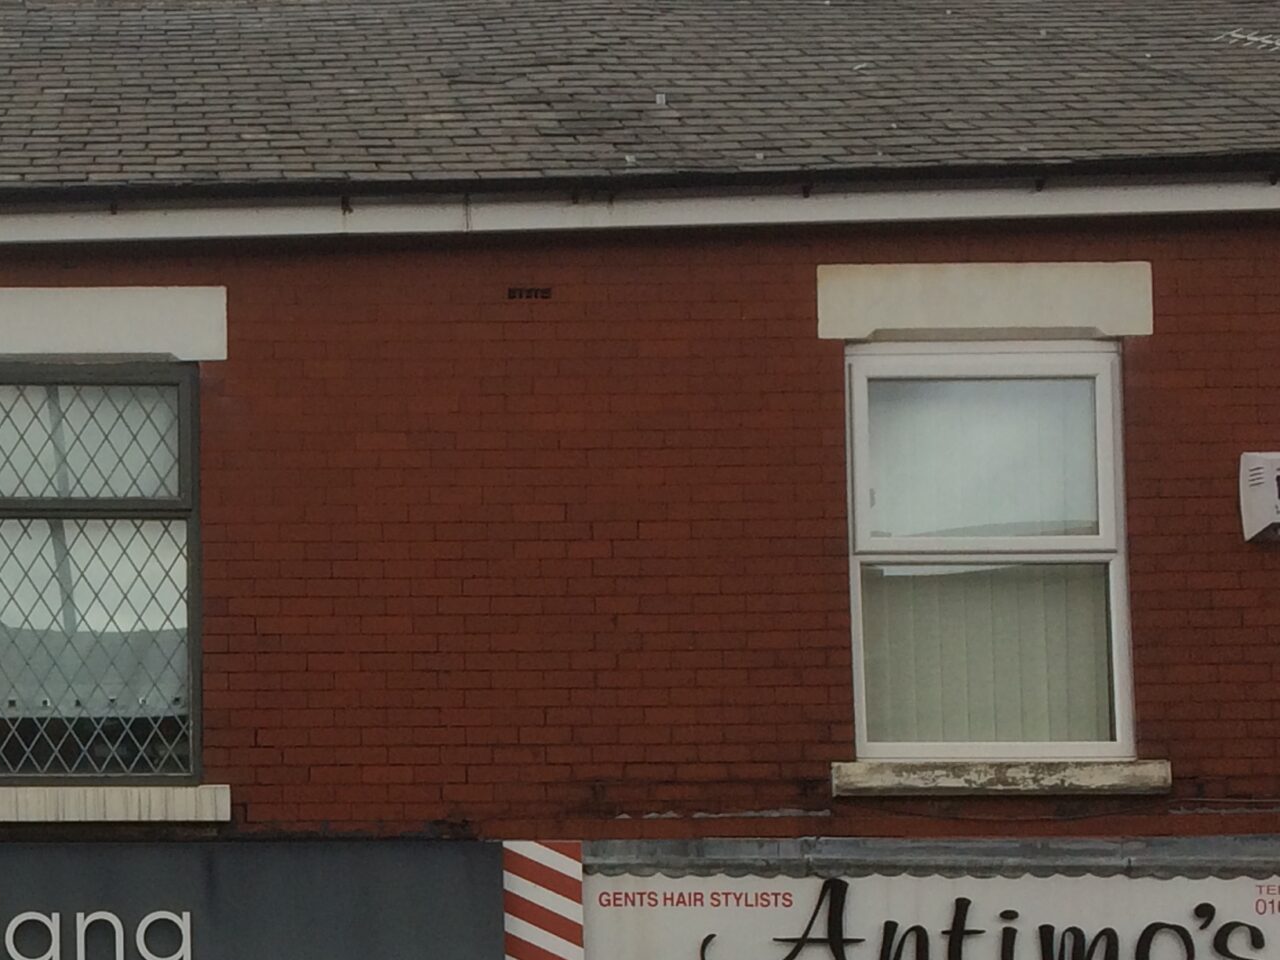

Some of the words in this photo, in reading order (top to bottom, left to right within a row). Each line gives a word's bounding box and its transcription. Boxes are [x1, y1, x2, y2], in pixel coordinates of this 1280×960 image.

[598, 891, 659, 908] GENTS
[662, 891, 705, 908] HAIR
[709, 891, 794, 908] STYLISTS
